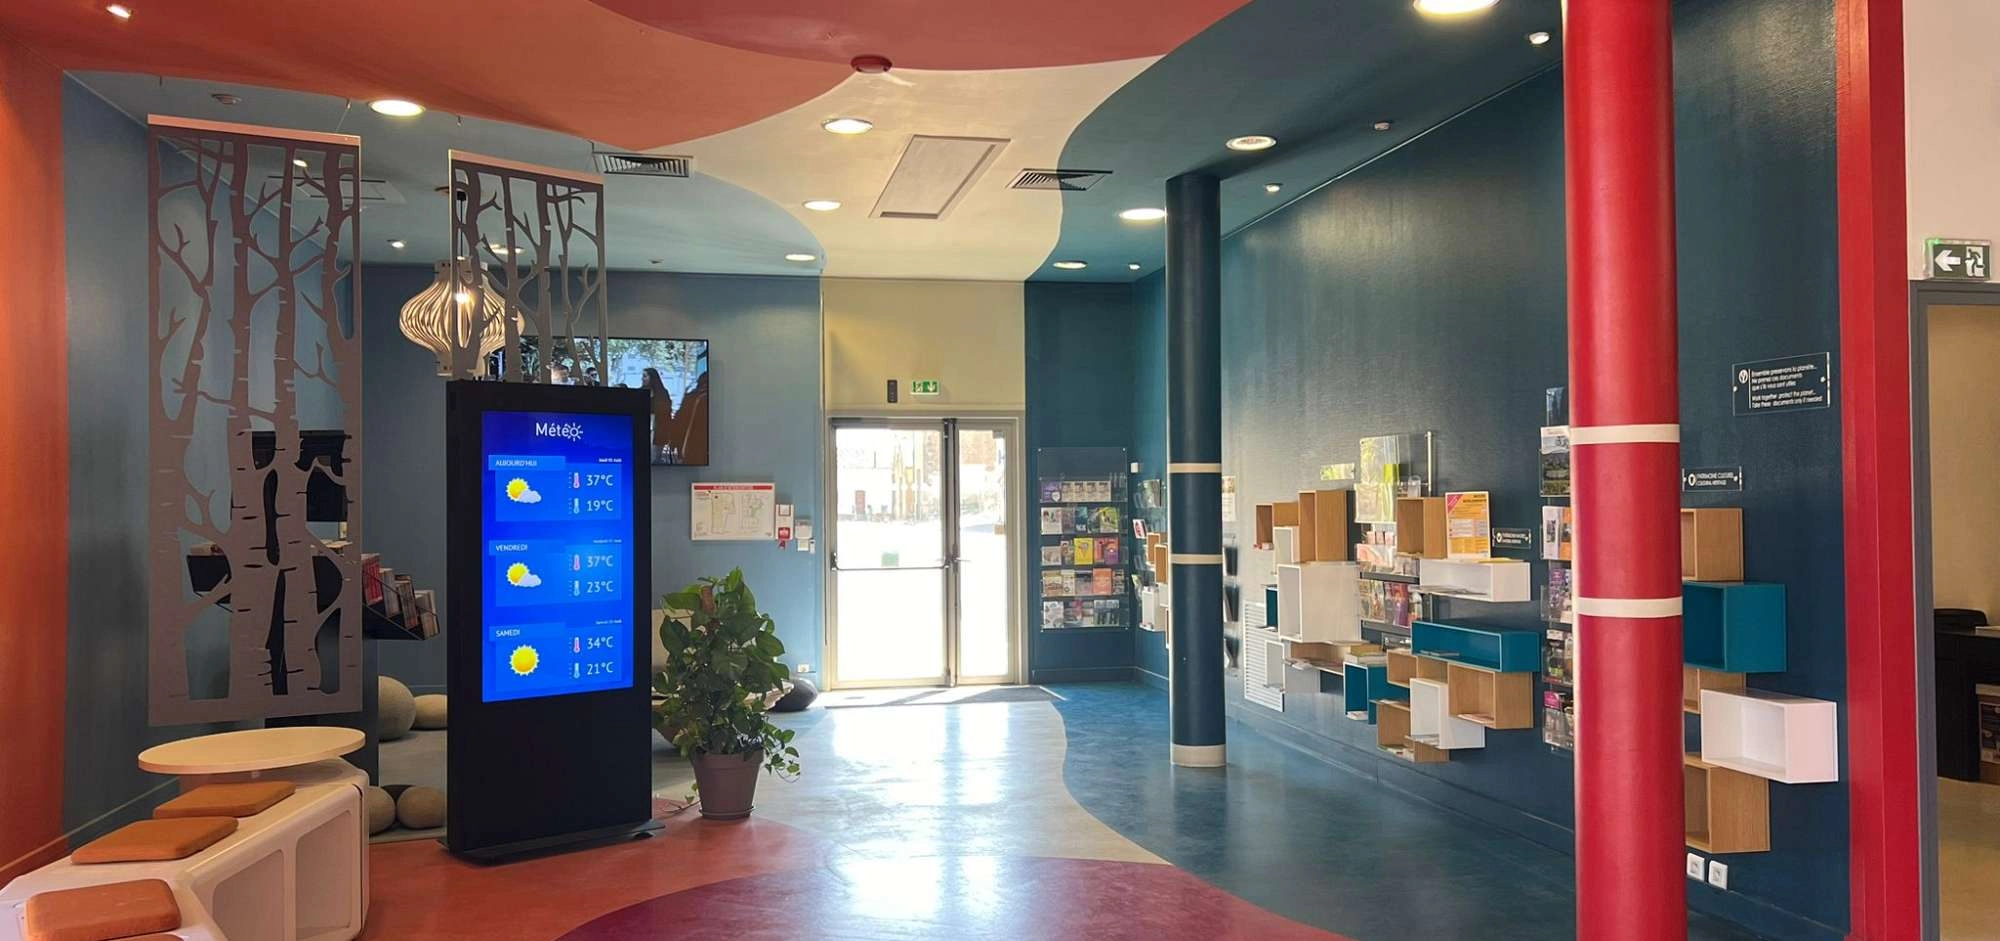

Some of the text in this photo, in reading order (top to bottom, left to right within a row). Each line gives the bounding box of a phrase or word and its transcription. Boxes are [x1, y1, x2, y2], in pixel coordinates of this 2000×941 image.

[535, 422, 580, 438] Météo
[586, 474, 614, 487] 37°C
[586, 499, 614, 512] 19°C
[495, 543, 528, 552] VENDREDI
[586, 555, 614, 568] 37°C
[586, 580, 614, 593] 23°C
[495, 628, 520, 638] SAMEDI
[586, 636, 614, 650] 34°C
[586, 661, 614, 675] 21°C
